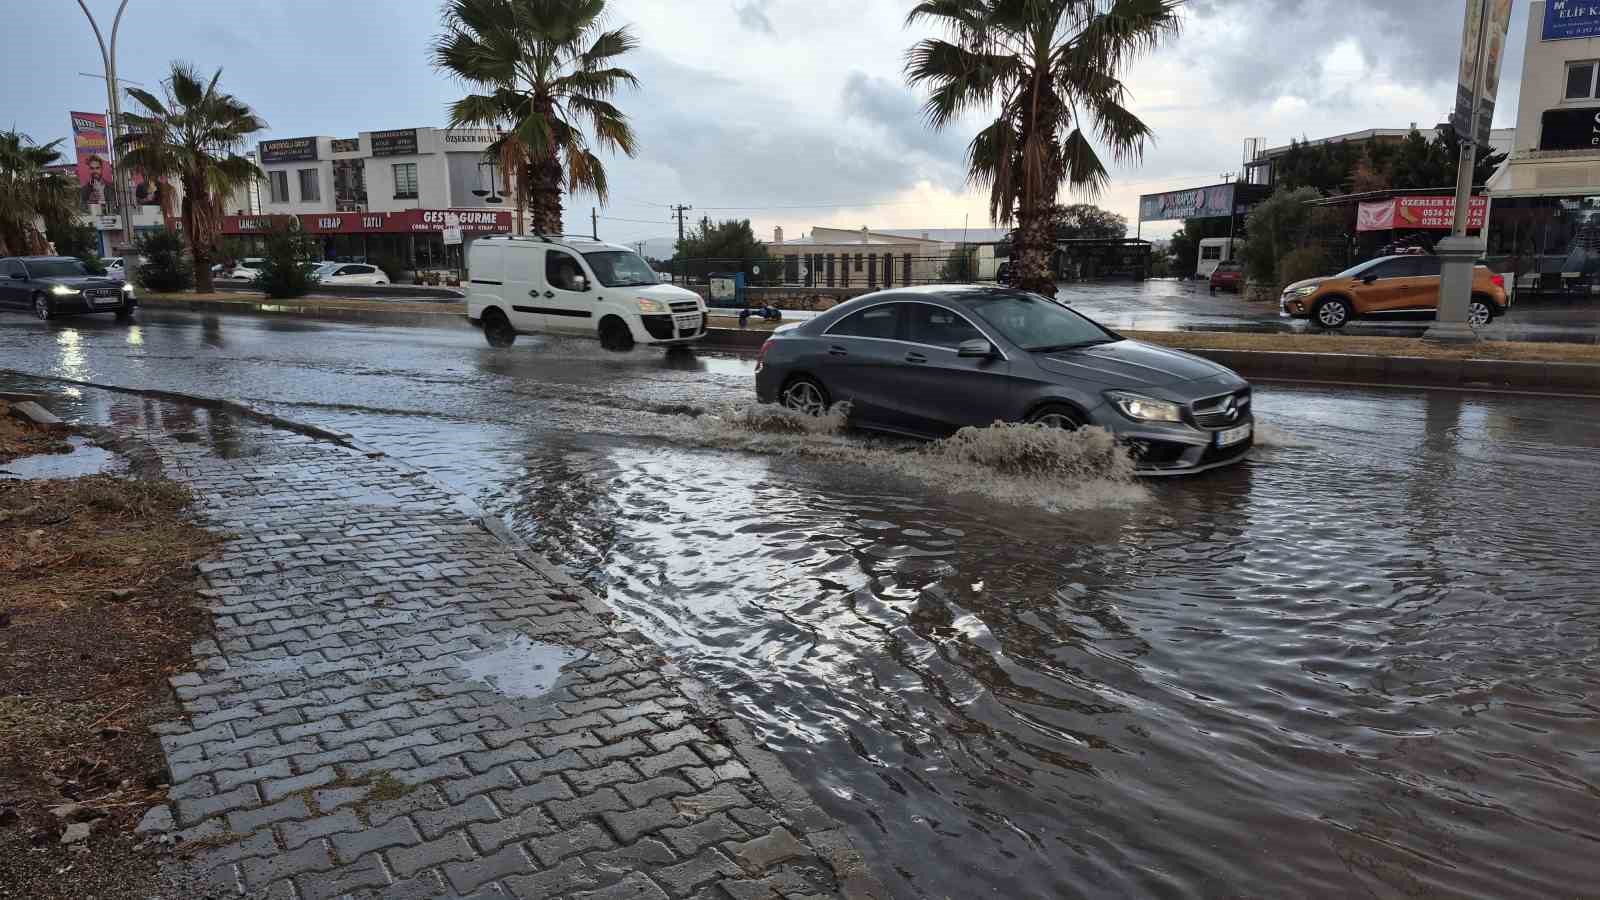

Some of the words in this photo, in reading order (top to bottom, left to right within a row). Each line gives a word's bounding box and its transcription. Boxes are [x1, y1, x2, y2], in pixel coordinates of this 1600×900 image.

[1560, 6, 1585, 18] ELİF
[319, 217, 341, 228] KEBAP
[363, 216, 382, 228] TATLI
[460, 212, 497, 224] GURME
